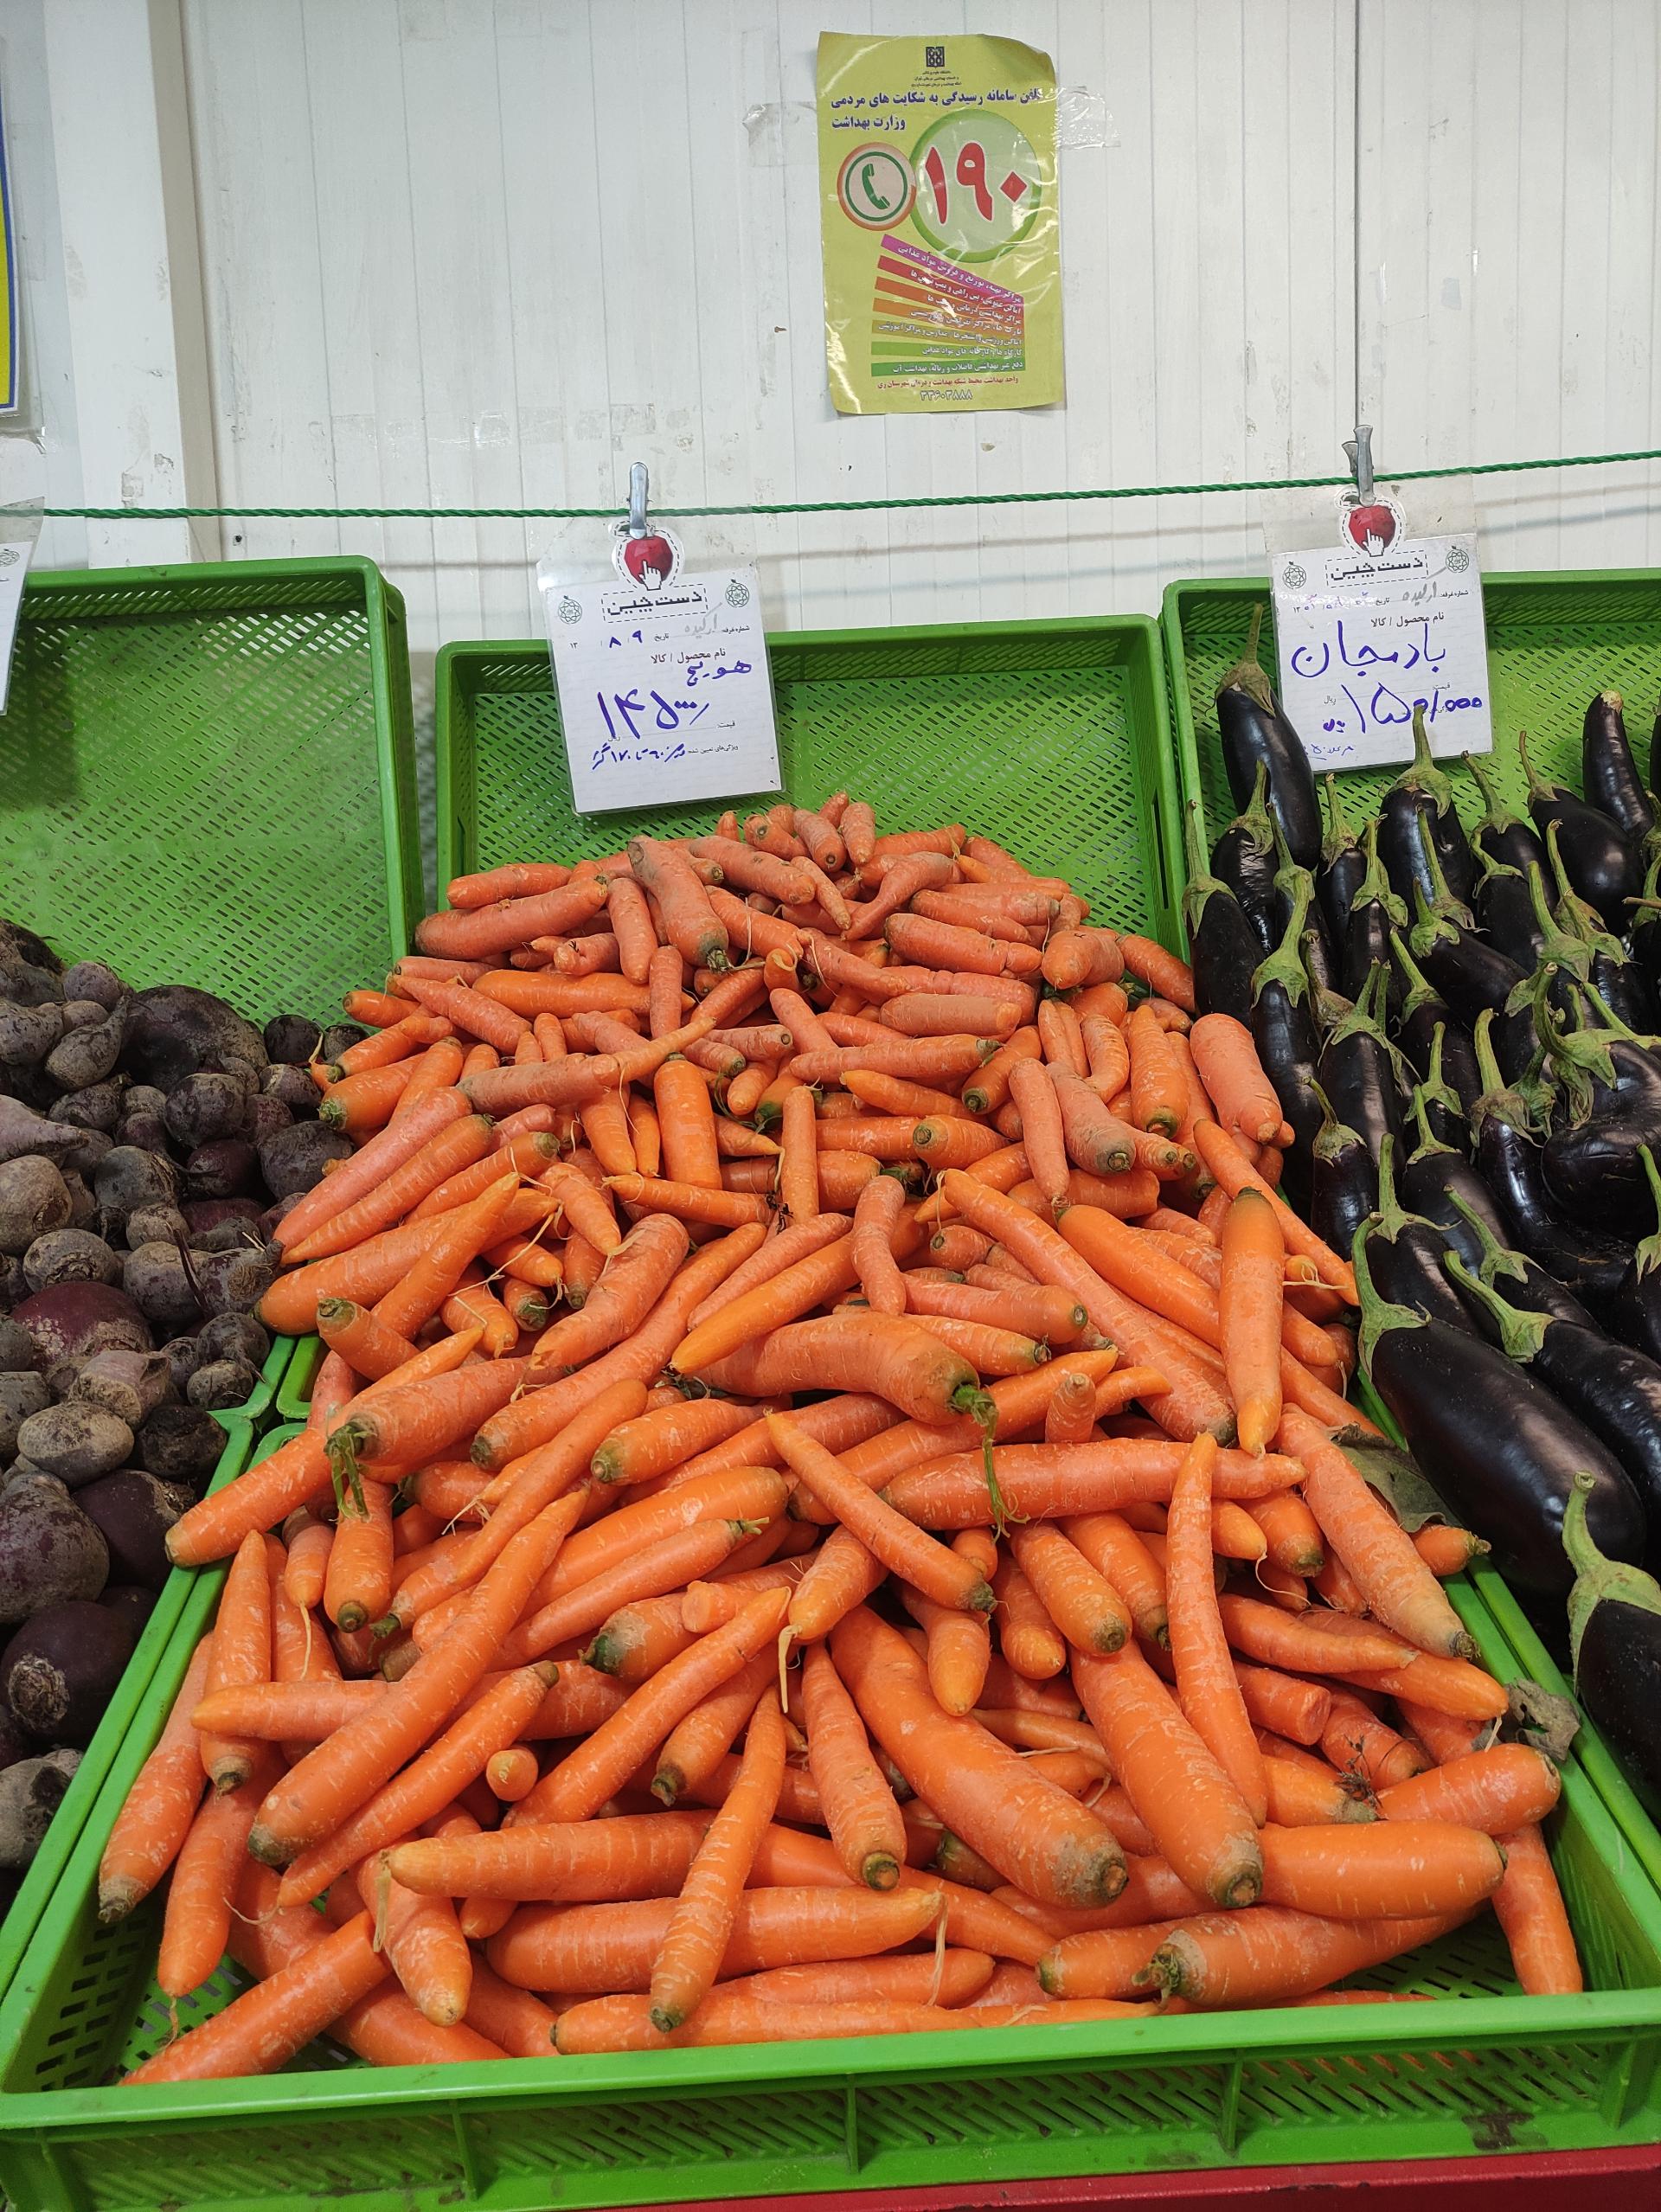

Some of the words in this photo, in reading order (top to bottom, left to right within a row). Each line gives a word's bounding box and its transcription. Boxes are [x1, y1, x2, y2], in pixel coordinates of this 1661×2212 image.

[831, 95, 866, 109] مردمی
[869, 92, 889, 108] های
[893, 91, 926, 106] شکایت
[929, 93, 939, 106] به
[942, 91, 983, 106] رسیدگی
[986, 89, 1016, 101] سامانه
[832, 116, 870, 131] بهداشت
[874, 114, 906, 131] وزارت
[925, 142, 1028, 225] ۱۹۰
[1370, 616, 1387, 628] کالا
[1396, 615, 1430, 628] محصول
[1433, 611, 1445, 625] نام
[653, 632, 670, 642] تاریخ
[715, 647, 727, 661] نام
[1292, 620, 1446, 677] بادمجان
[651, 652, 667, 665] کالا
[677, 651, 712, 664] محصول
[687, 660, 753, 687] هویج
